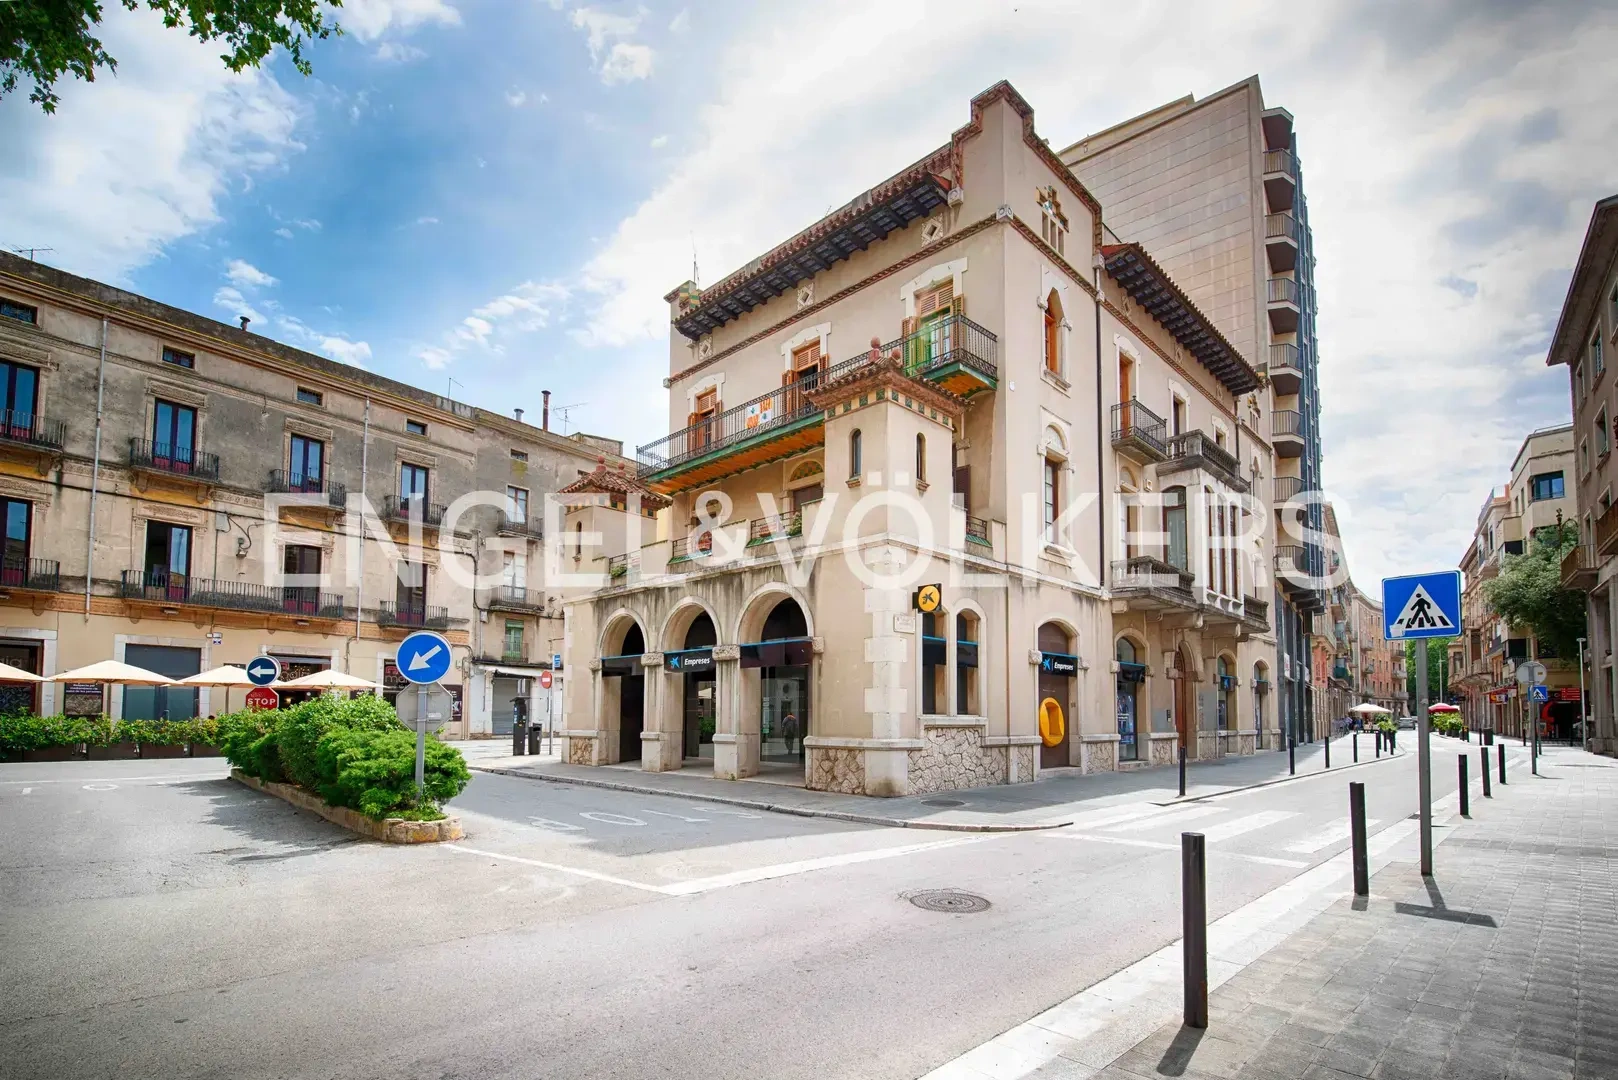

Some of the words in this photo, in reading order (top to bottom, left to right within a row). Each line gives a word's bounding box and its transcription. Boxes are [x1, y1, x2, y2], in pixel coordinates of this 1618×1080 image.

[684, 656, 711, 667] Empreses
[1053, 661, 1074, 672] Empreses
[247, 698, 276, 706] STOP
